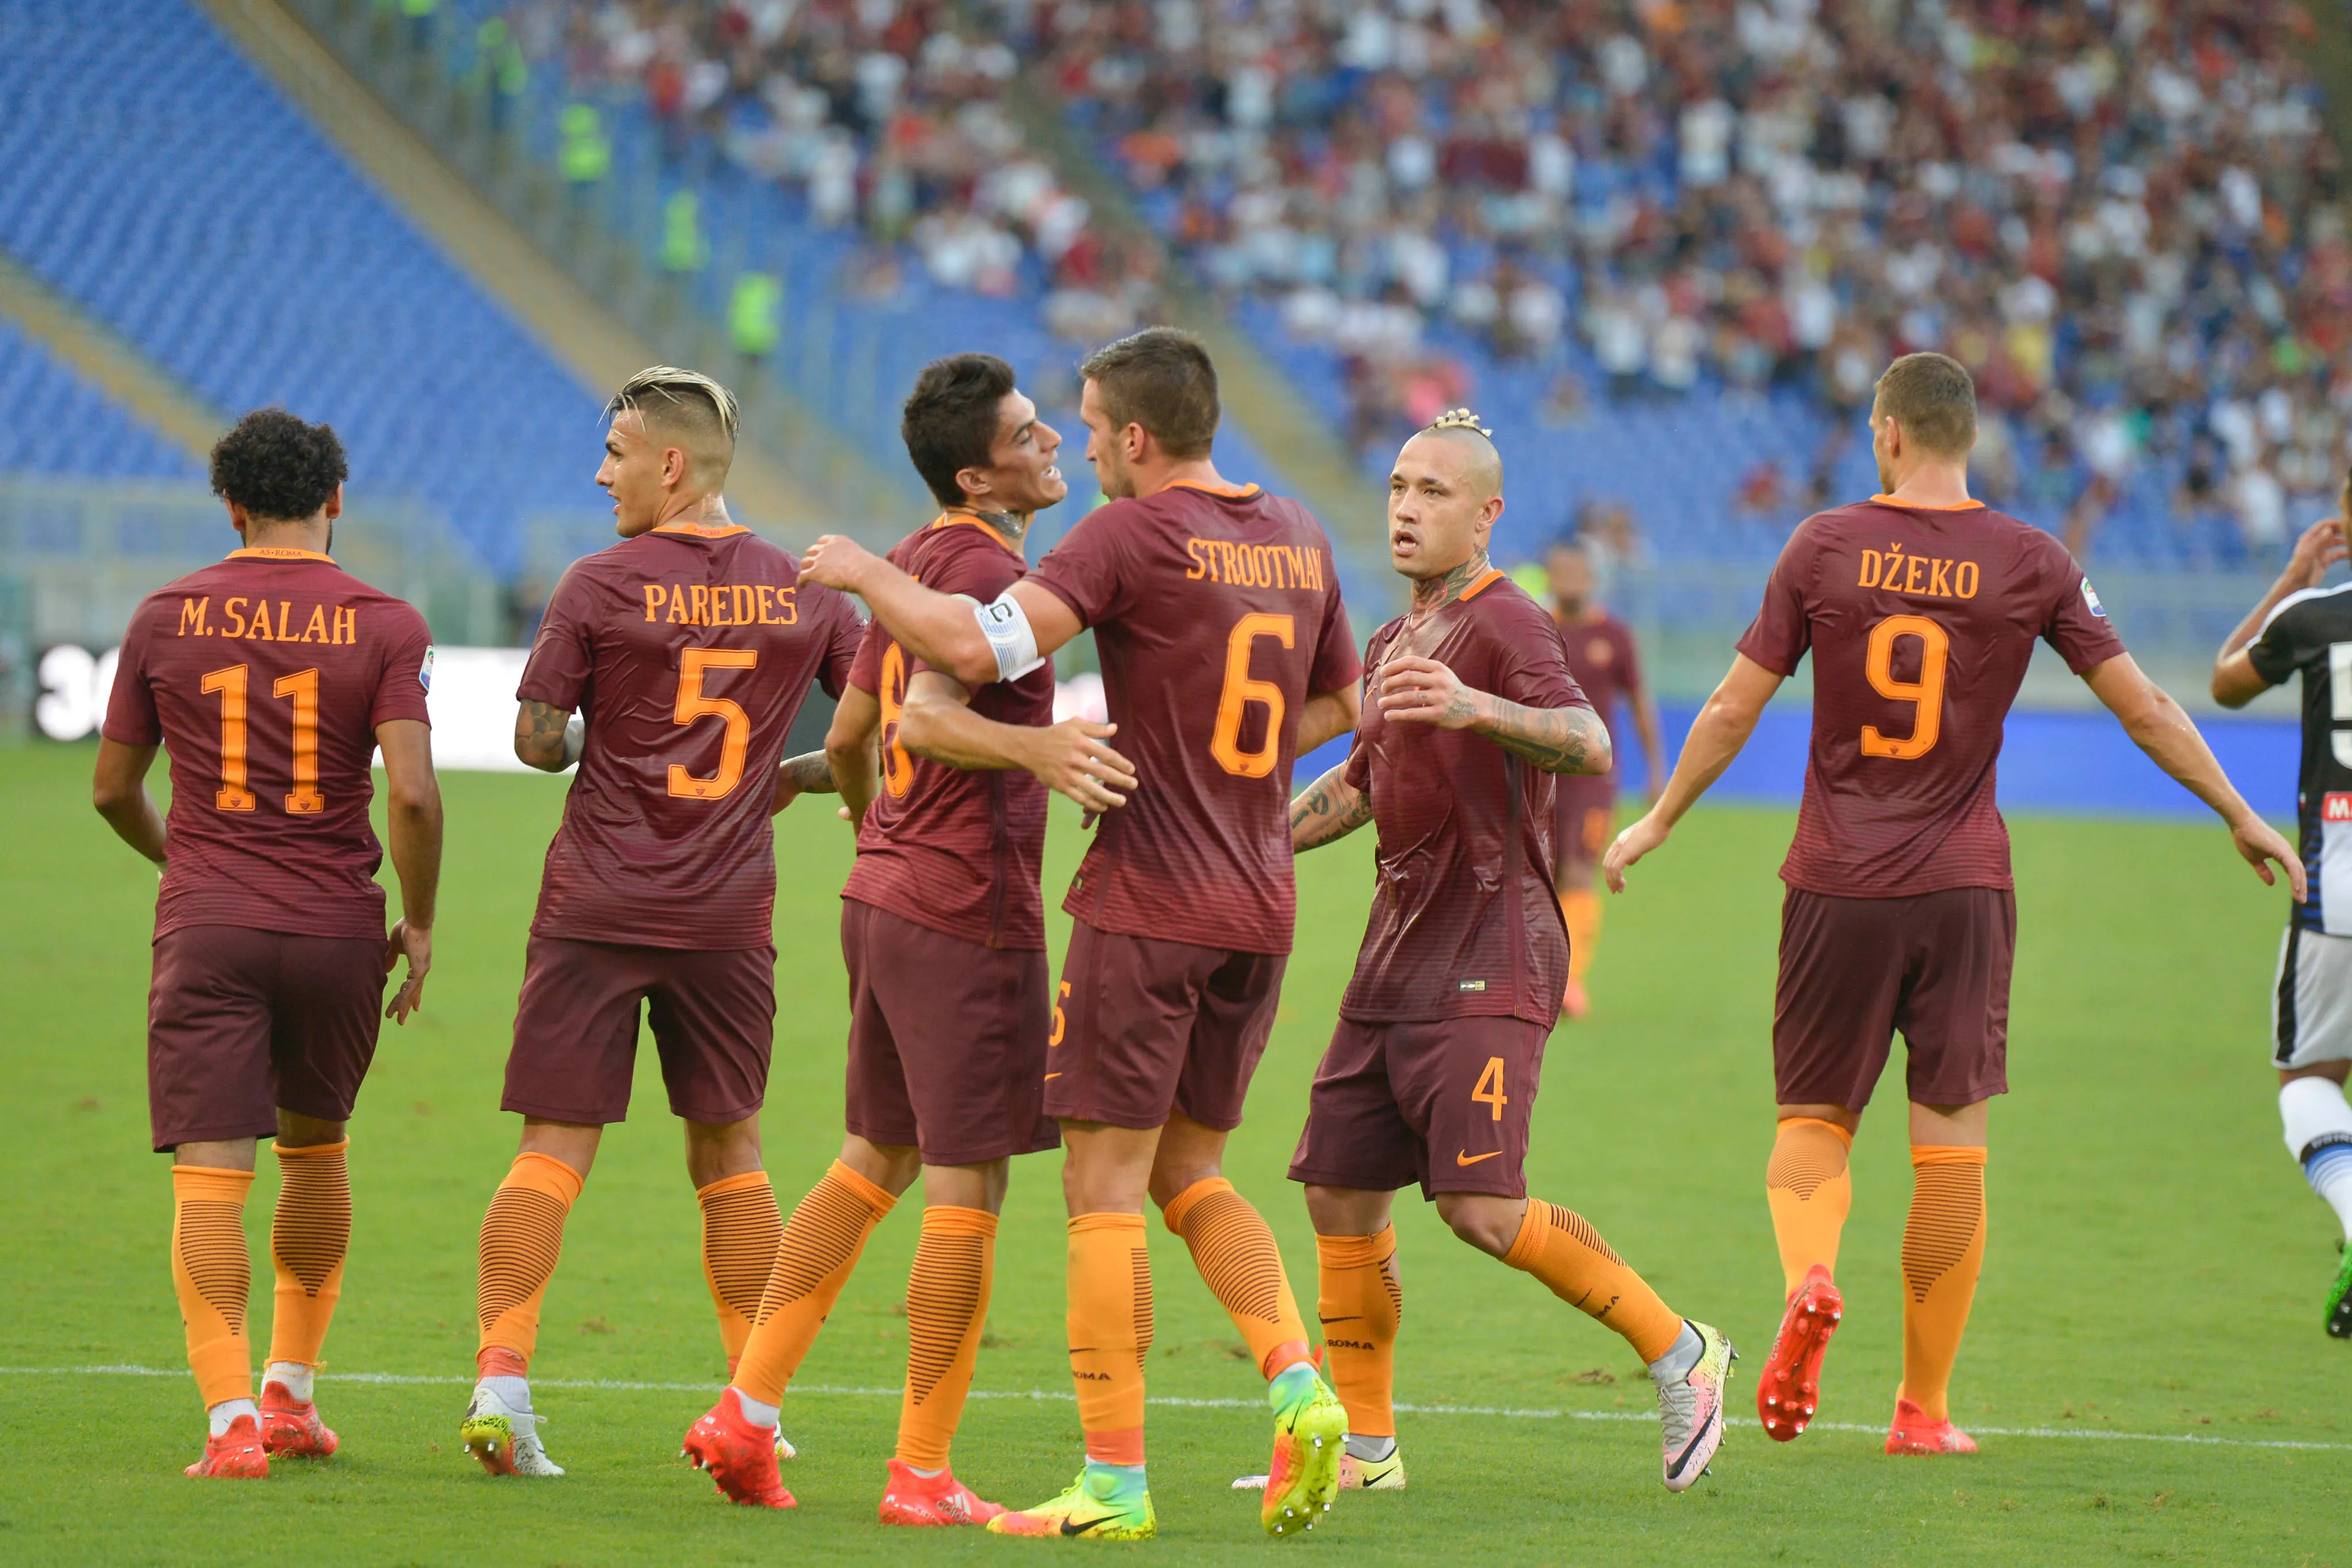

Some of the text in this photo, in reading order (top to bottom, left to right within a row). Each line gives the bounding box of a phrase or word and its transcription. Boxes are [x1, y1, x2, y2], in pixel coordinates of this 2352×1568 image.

[643, 584, 798, 627] PAREDES
[1185, 537, 1324, 592] STROOTMAN
[1858, 542, 1980, 599] DŽEKO
[201, 663, 325, 814] 11
[668, 647, 758, 801] 5
[1210, 612, 1295, 778] 6
[1861, 614, 1949, 760] 9
[1471, 1057, 1508, 1121] 4
